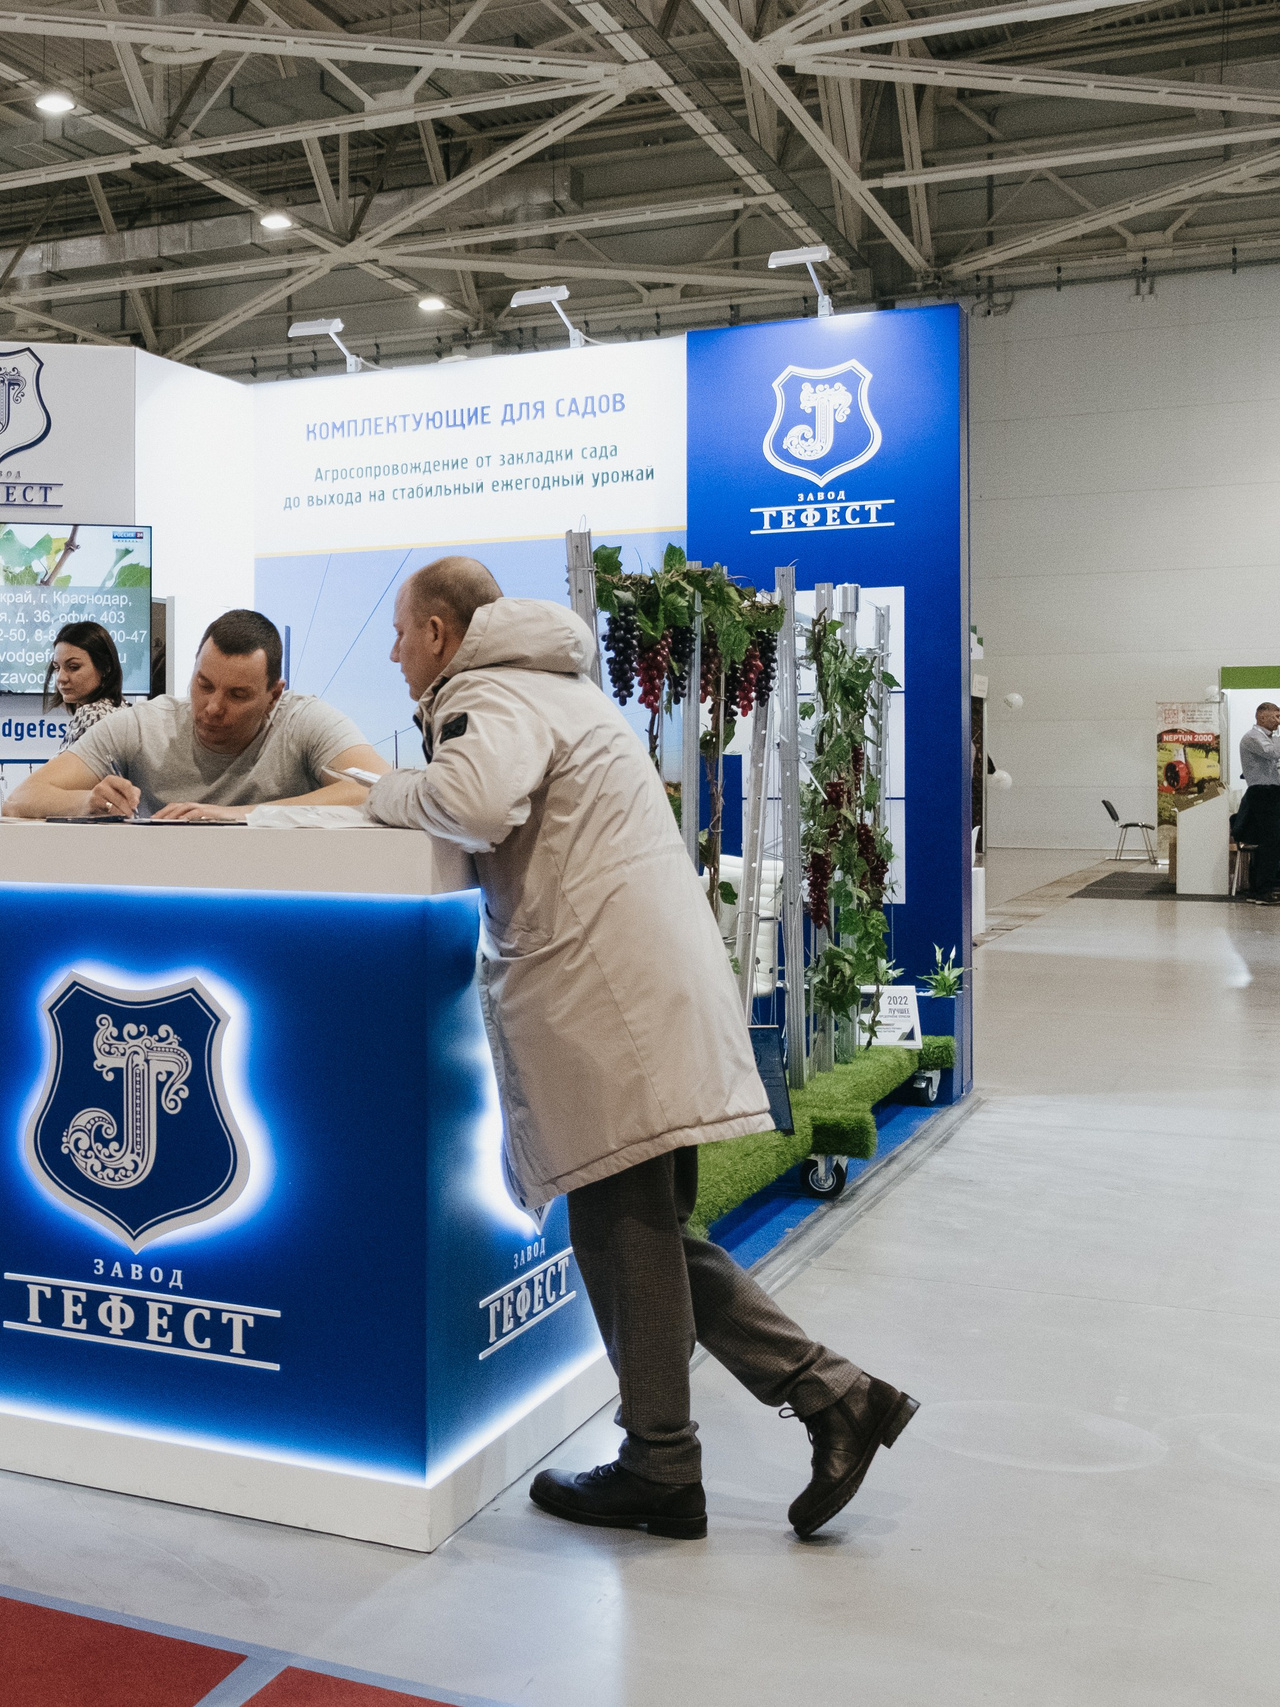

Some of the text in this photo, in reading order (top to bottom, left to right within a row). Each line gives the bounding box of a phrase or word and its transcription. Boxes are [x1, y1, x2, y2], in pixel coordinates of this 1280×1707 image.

[306, 392, 626, 441] КОМПЛЕКТУЮЩИЕ ДЛЯ САДОВ
[314, 444, 618, 483] Агросопровождение от закладки сада
[283, 464, 655, 511] до выхода на стабильный ежегодный урожай
[797, 490, 846, 502] ЗАВОД
[762, 504, 883, 530] ГЕФЕСТ
[0, 591, 36, 607] край,
[40, 593, 48, 603] г.
[53, 591, 132, 606] Краснодар,
[16, 612, 29, 623] д.
[33, 610, 54, 624] 36,
[59, 611, 96, 623] офис
[100, 611, 125, 624] 403
[1163, 734, 1213, 742] NEPTUN 2000
[887, 995, 909, 1006] 2022
[513, 1237, 546, 1269] ЗАВОД
[93, 1258, 183, 1289] ЗАВОД
[488, 1256, 569, 1343] ГЕФЕСТ
[27, 1284, 255, 1355] ГЕФЕСТ
